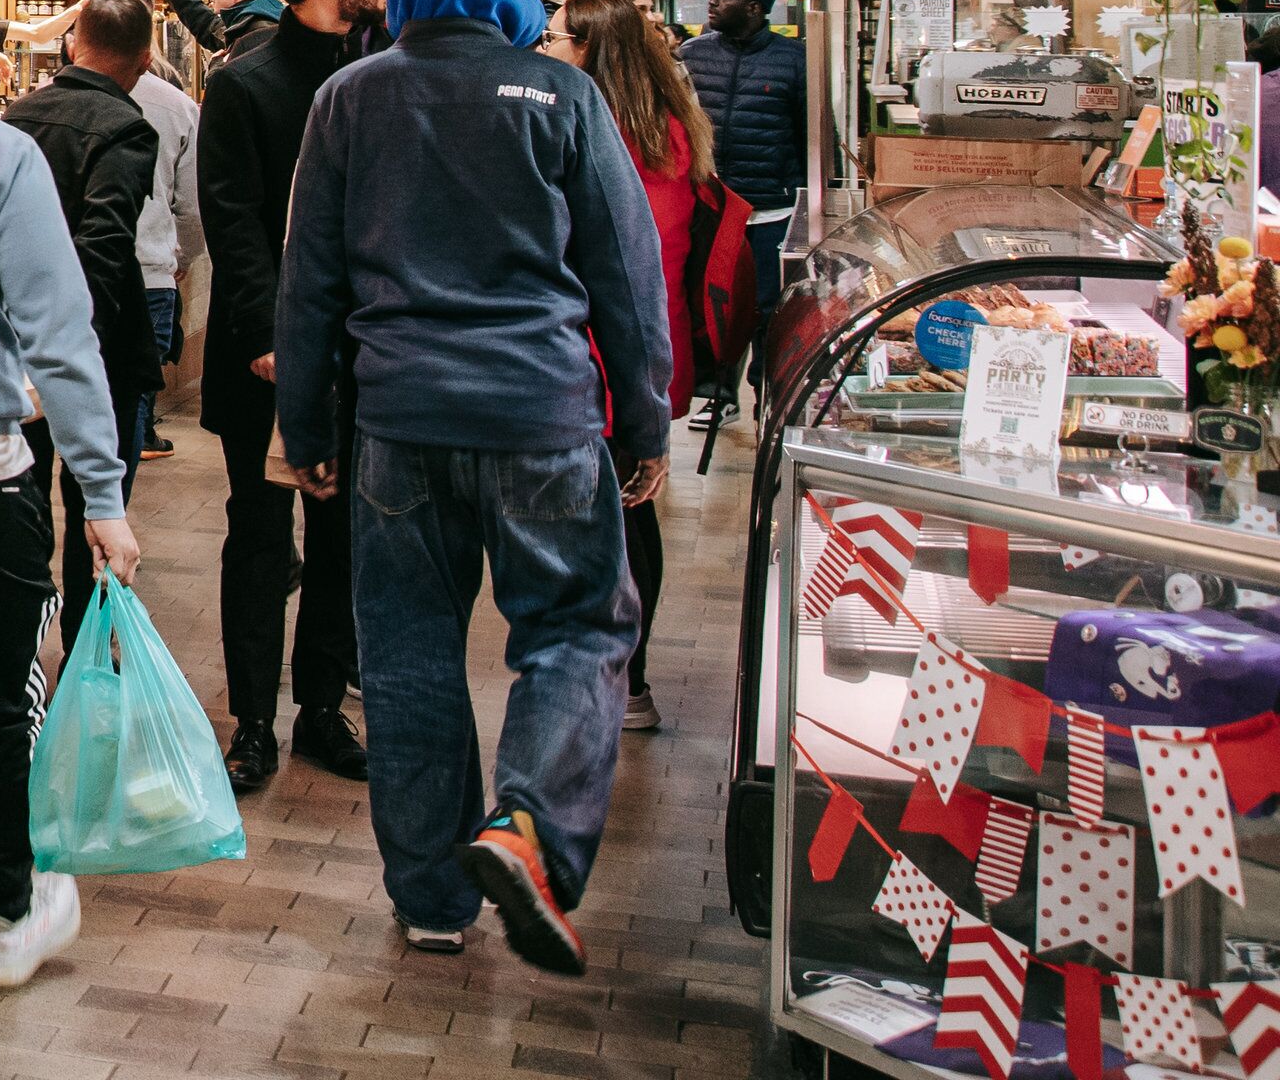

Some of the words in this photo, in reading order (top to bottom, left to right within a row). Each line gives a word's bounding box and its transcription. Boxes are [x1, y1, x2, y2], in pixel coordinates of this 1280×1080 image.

[921, 7, 946, 18] SHEET
[497, 84, 524, 97] PENN
[524, 86, 557, 105] STATE
[963, 88, 1040, 100] HOBART
[1085, 87, 1113, 96] CAUTION
[927, 327, 964, 339] CHECK
[937, 338, 966, 348] HERE
[987, 368, 1045, 388] PARTY
[1122, 410, 1136, 420] NO
[1139, 412, 1168, 422] FOOD
[1119, 419, 1135, 428] OR
[1137, 421, 1170, 432] DRINK
